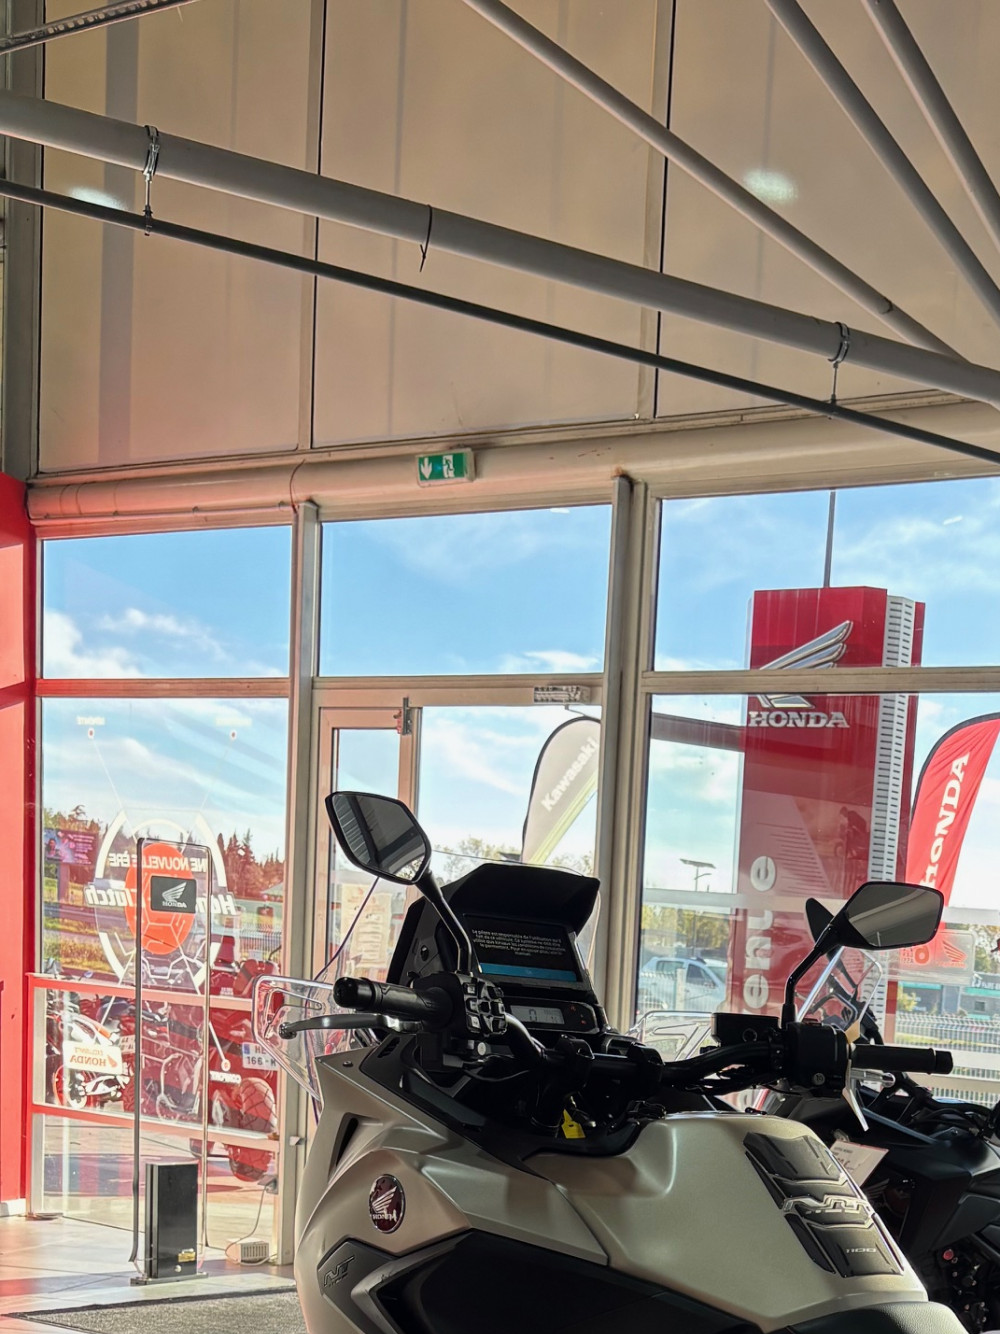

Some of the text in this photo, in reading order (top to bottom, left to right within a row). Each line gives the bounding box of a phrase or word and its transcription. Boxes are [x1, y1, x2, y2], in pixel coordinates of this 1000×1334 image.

[748, 711, 850, 728] HONDA
[541, 737, 599, 812] Kawasaki
[919, 751, 970, 889] HONDA
